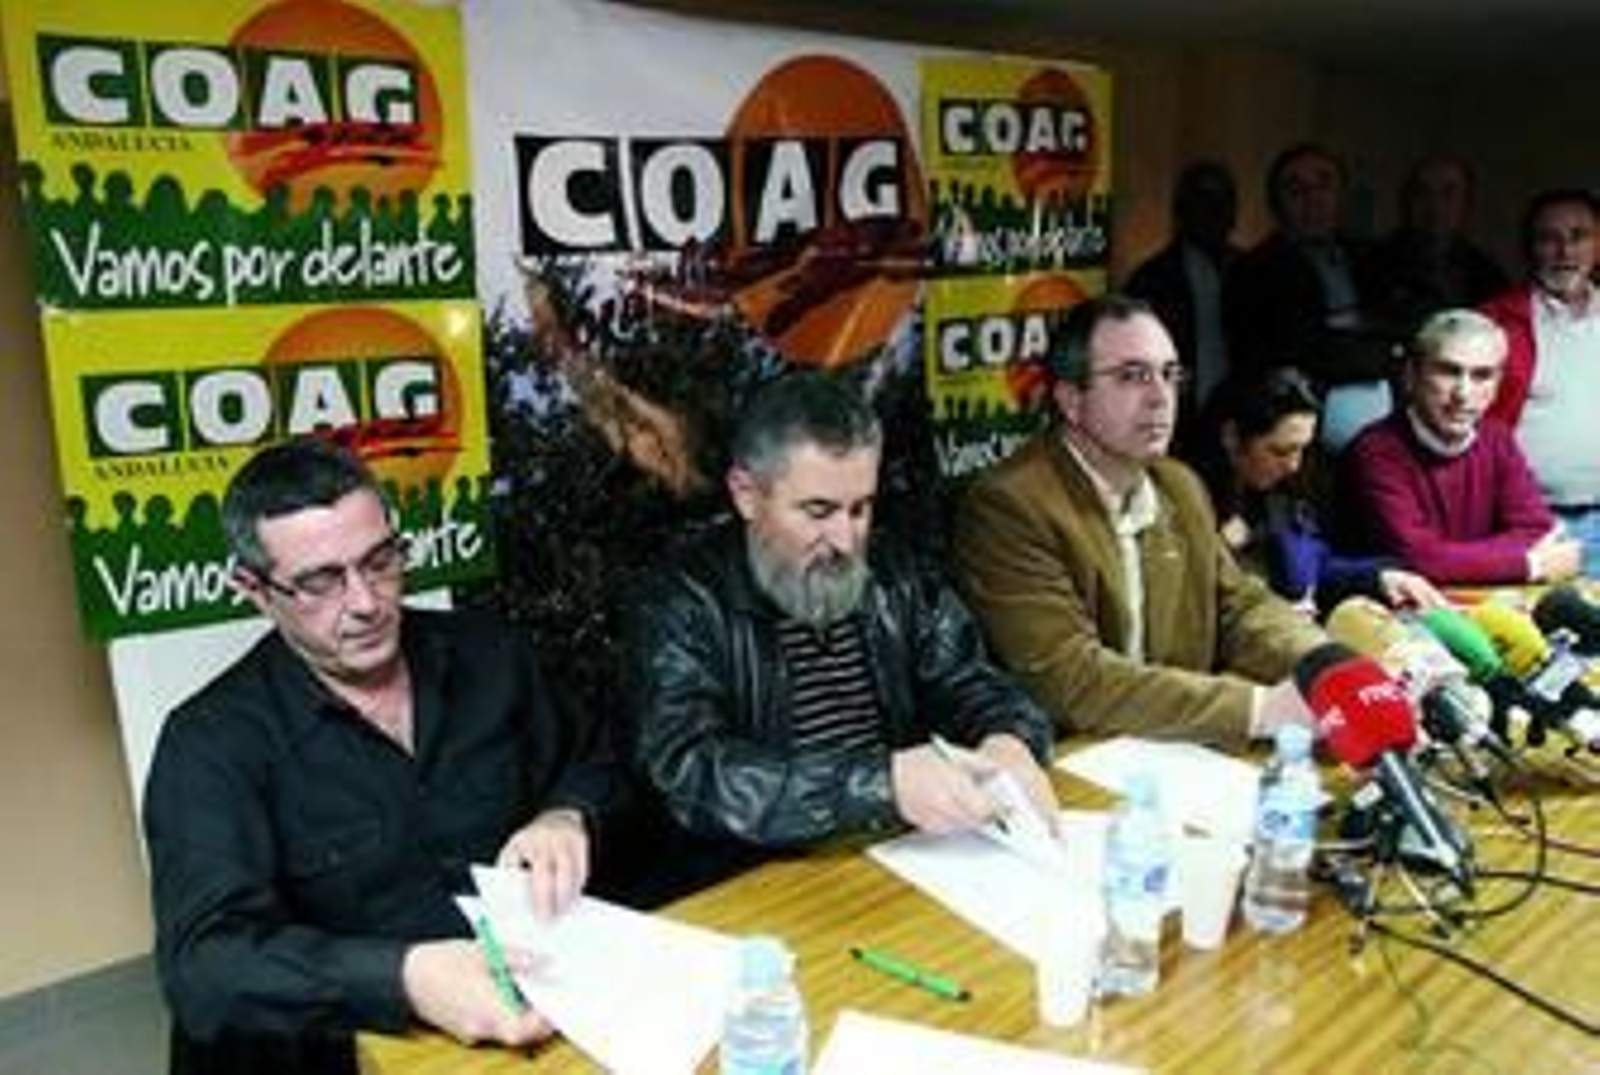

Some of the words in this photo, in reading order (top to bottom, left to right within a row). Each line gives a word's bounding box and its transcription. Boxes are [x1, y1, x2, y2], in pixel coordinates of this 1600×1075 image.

[50, 45, 415, 126] COAG
[943, 104, 1087, 152] COAG
[528, 139, 898, 248] COAG
[51, 221, 214, 297] Vamos
[224, 246, 295, 304] por
[303, 219, 463, 286] delante
[942, 314, 1049, 370] COA
[95, 361, 438, 453] COAG
[390, 508, 482, 570] ante
